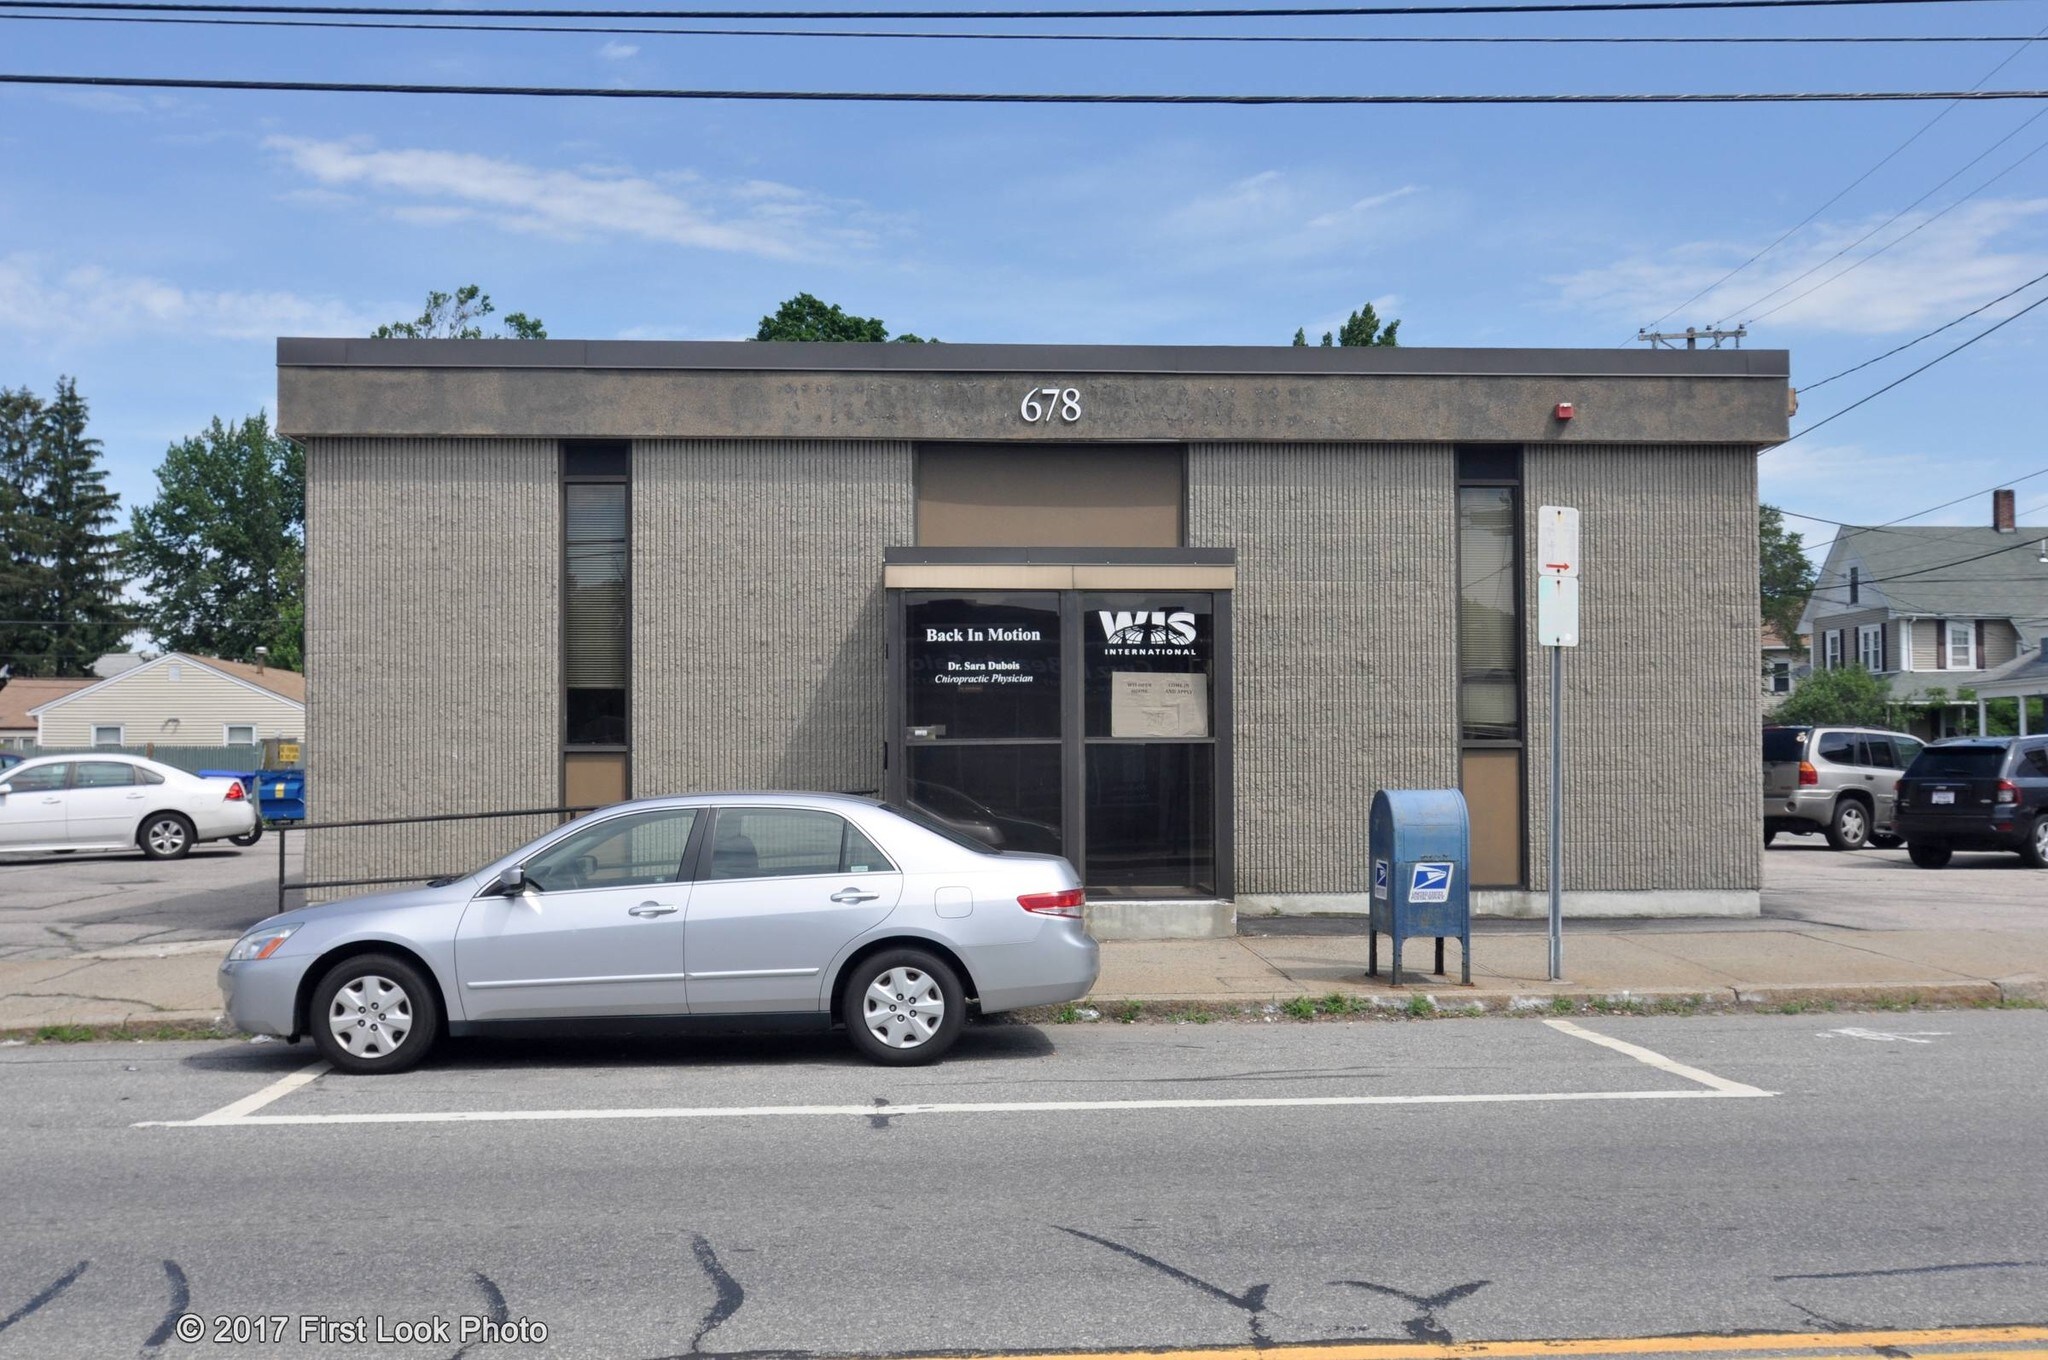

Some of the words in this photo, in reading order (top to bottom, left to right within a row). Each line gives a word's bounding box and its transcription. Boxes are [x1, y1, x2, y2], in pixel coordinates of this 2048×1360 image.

[1021, 387, 1082, 422] 678
[1099, 611, 1197, 645] WIS
[926, 628, 964, 642] Back
[967, 628, 984, 642] In
[988, 628, 1041, 641] Motion
[1104, 648, 1197, 656] INTERNATIONAL
[948, 661, 962, 671] Dr.
[964, 661, 986, 671] Sara
[988, 661, 1020, 670] Dubois
[935, 674, 989, 685] Chiropractic
[991, 674, 1033, 685] Physician
